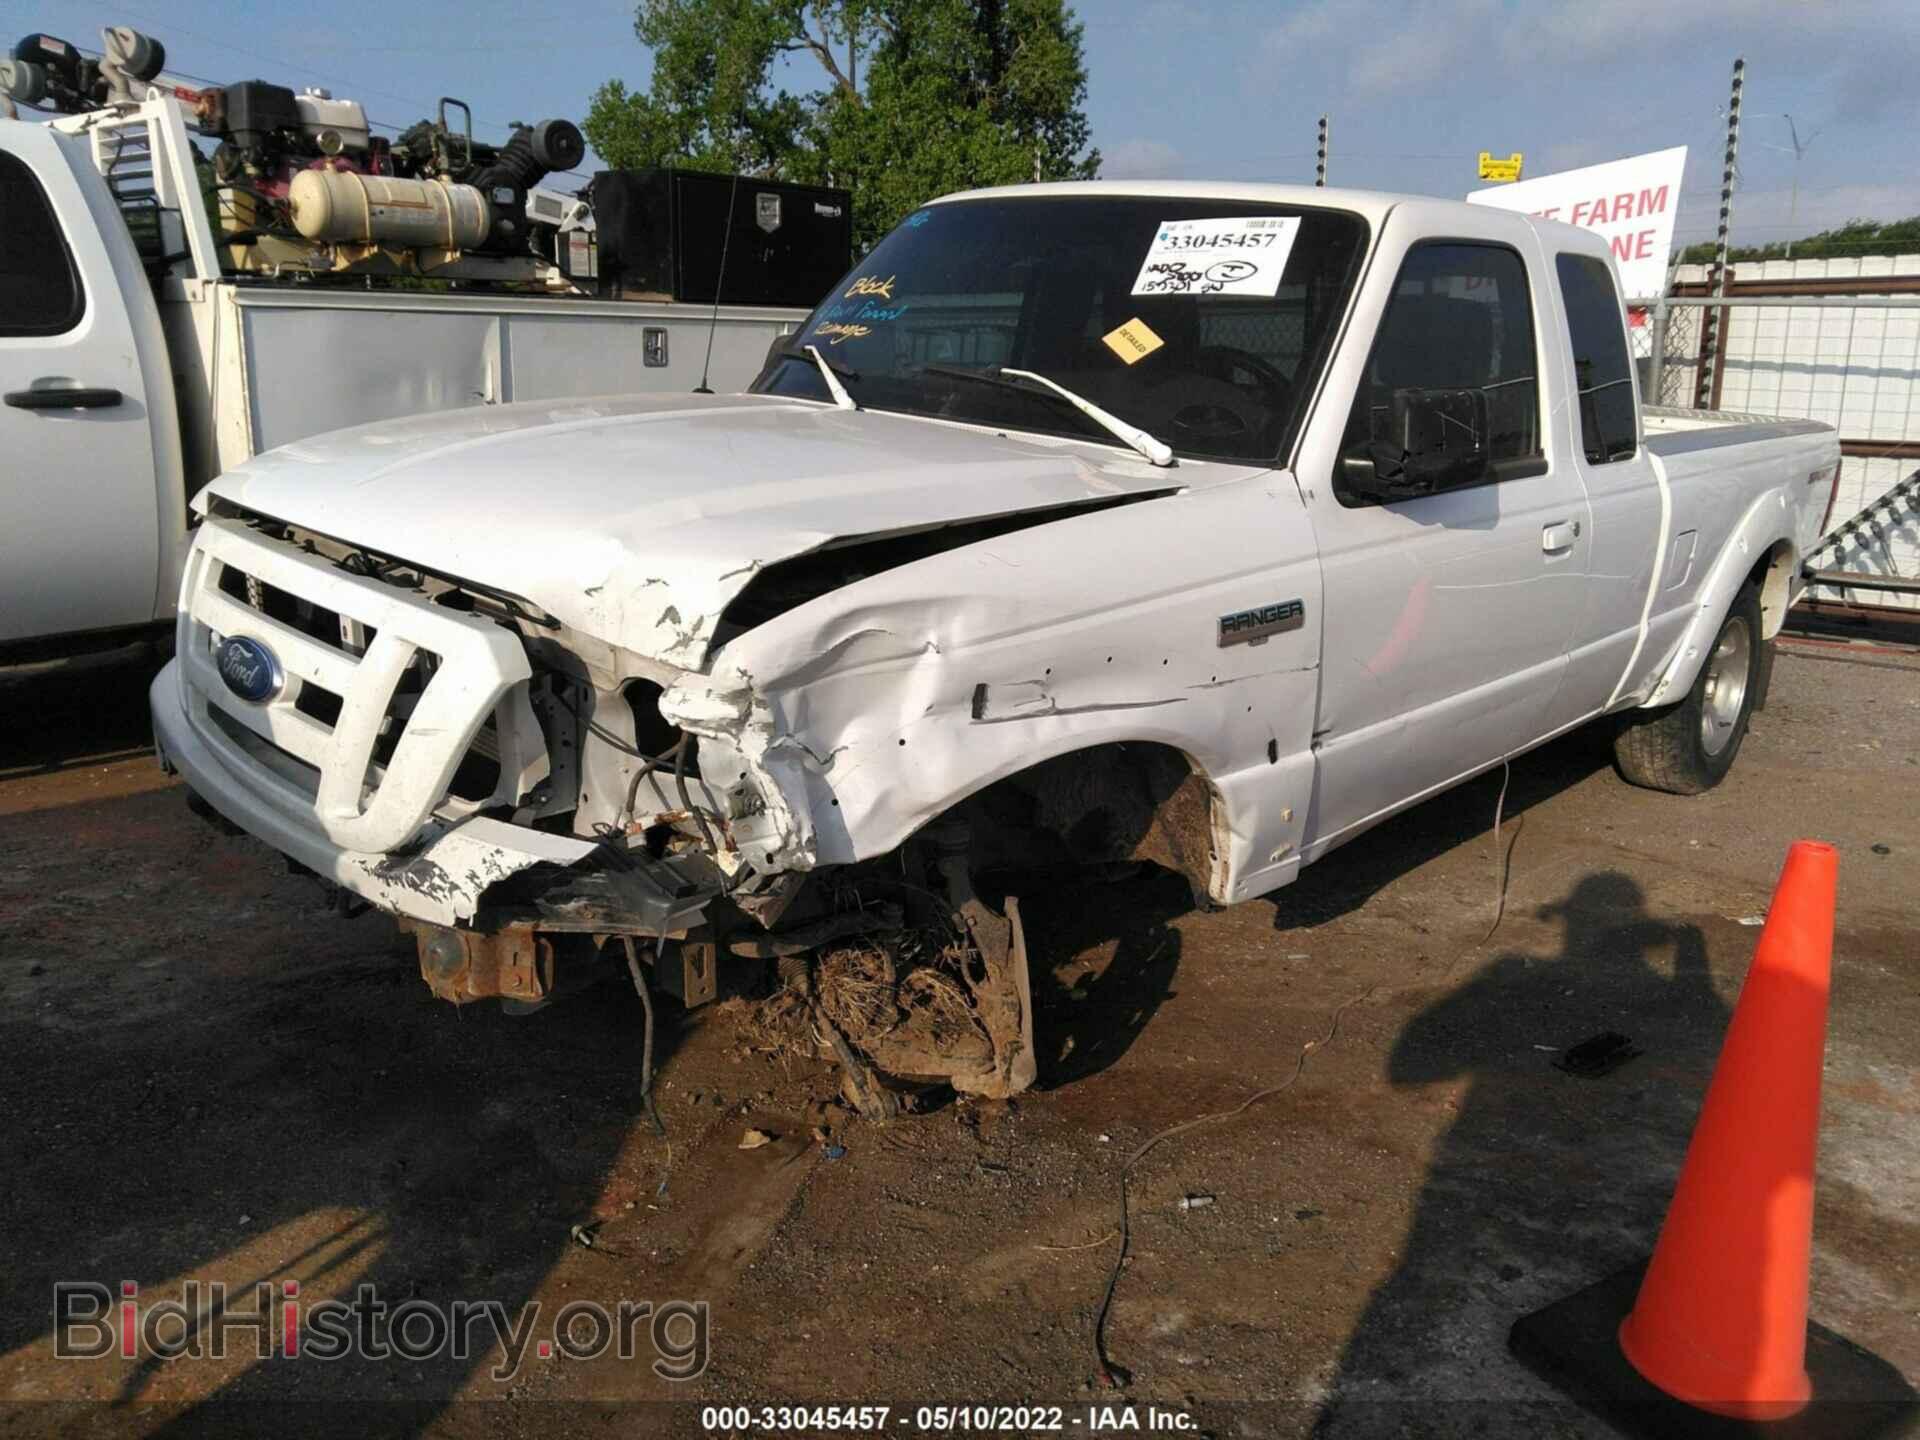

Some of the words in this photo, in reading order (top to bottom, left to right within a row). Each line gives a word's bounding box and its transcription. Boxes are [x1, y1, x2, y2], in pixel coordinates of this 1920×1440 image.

[1571, 184, 1669, 226] FARM
[1165, 233, 1277, 250] 33045457
[1611, 229, 1656, 262] NE
[1220, 600, 1303, 635] RANGER
[224, 643, 260, 688] Ford
